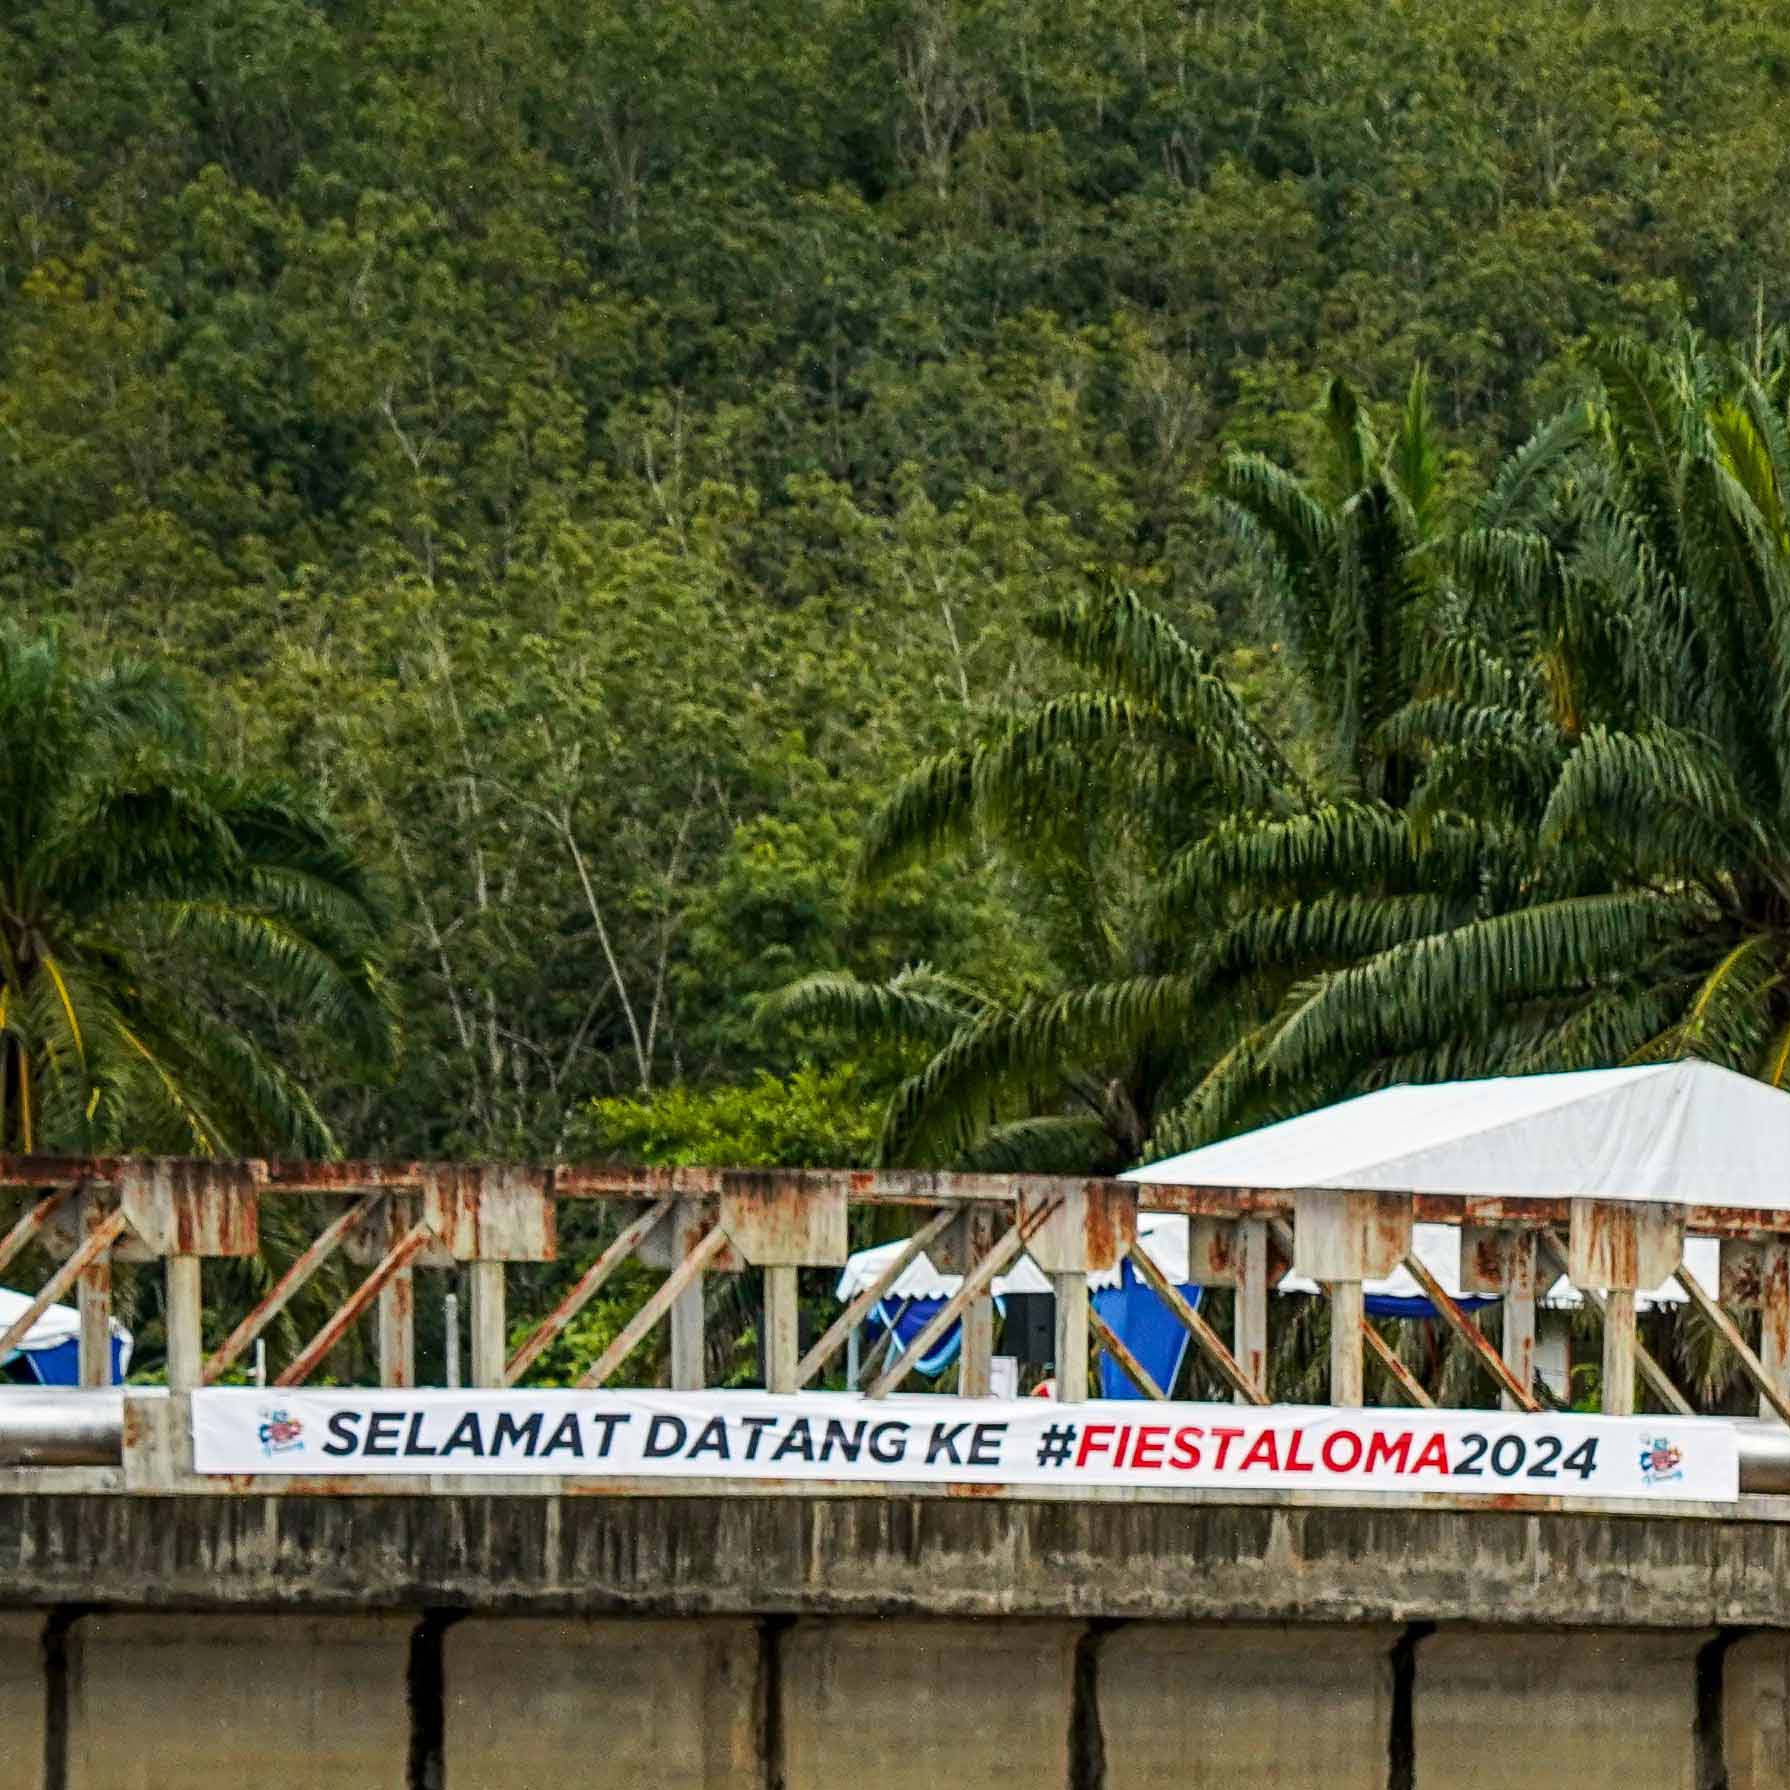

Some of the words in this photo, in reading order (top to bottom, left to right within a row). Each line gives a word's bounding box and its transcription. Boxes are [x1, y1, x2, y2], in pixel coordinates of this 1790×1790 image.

[322, 1410, 631, 1458] SELAMAT
[643, 1414, 907, 1463] DATANG
[925, 1422, 1009, 1466] KE
[1036, 1423, 1600, 1480] #FIESTALOMA2024
